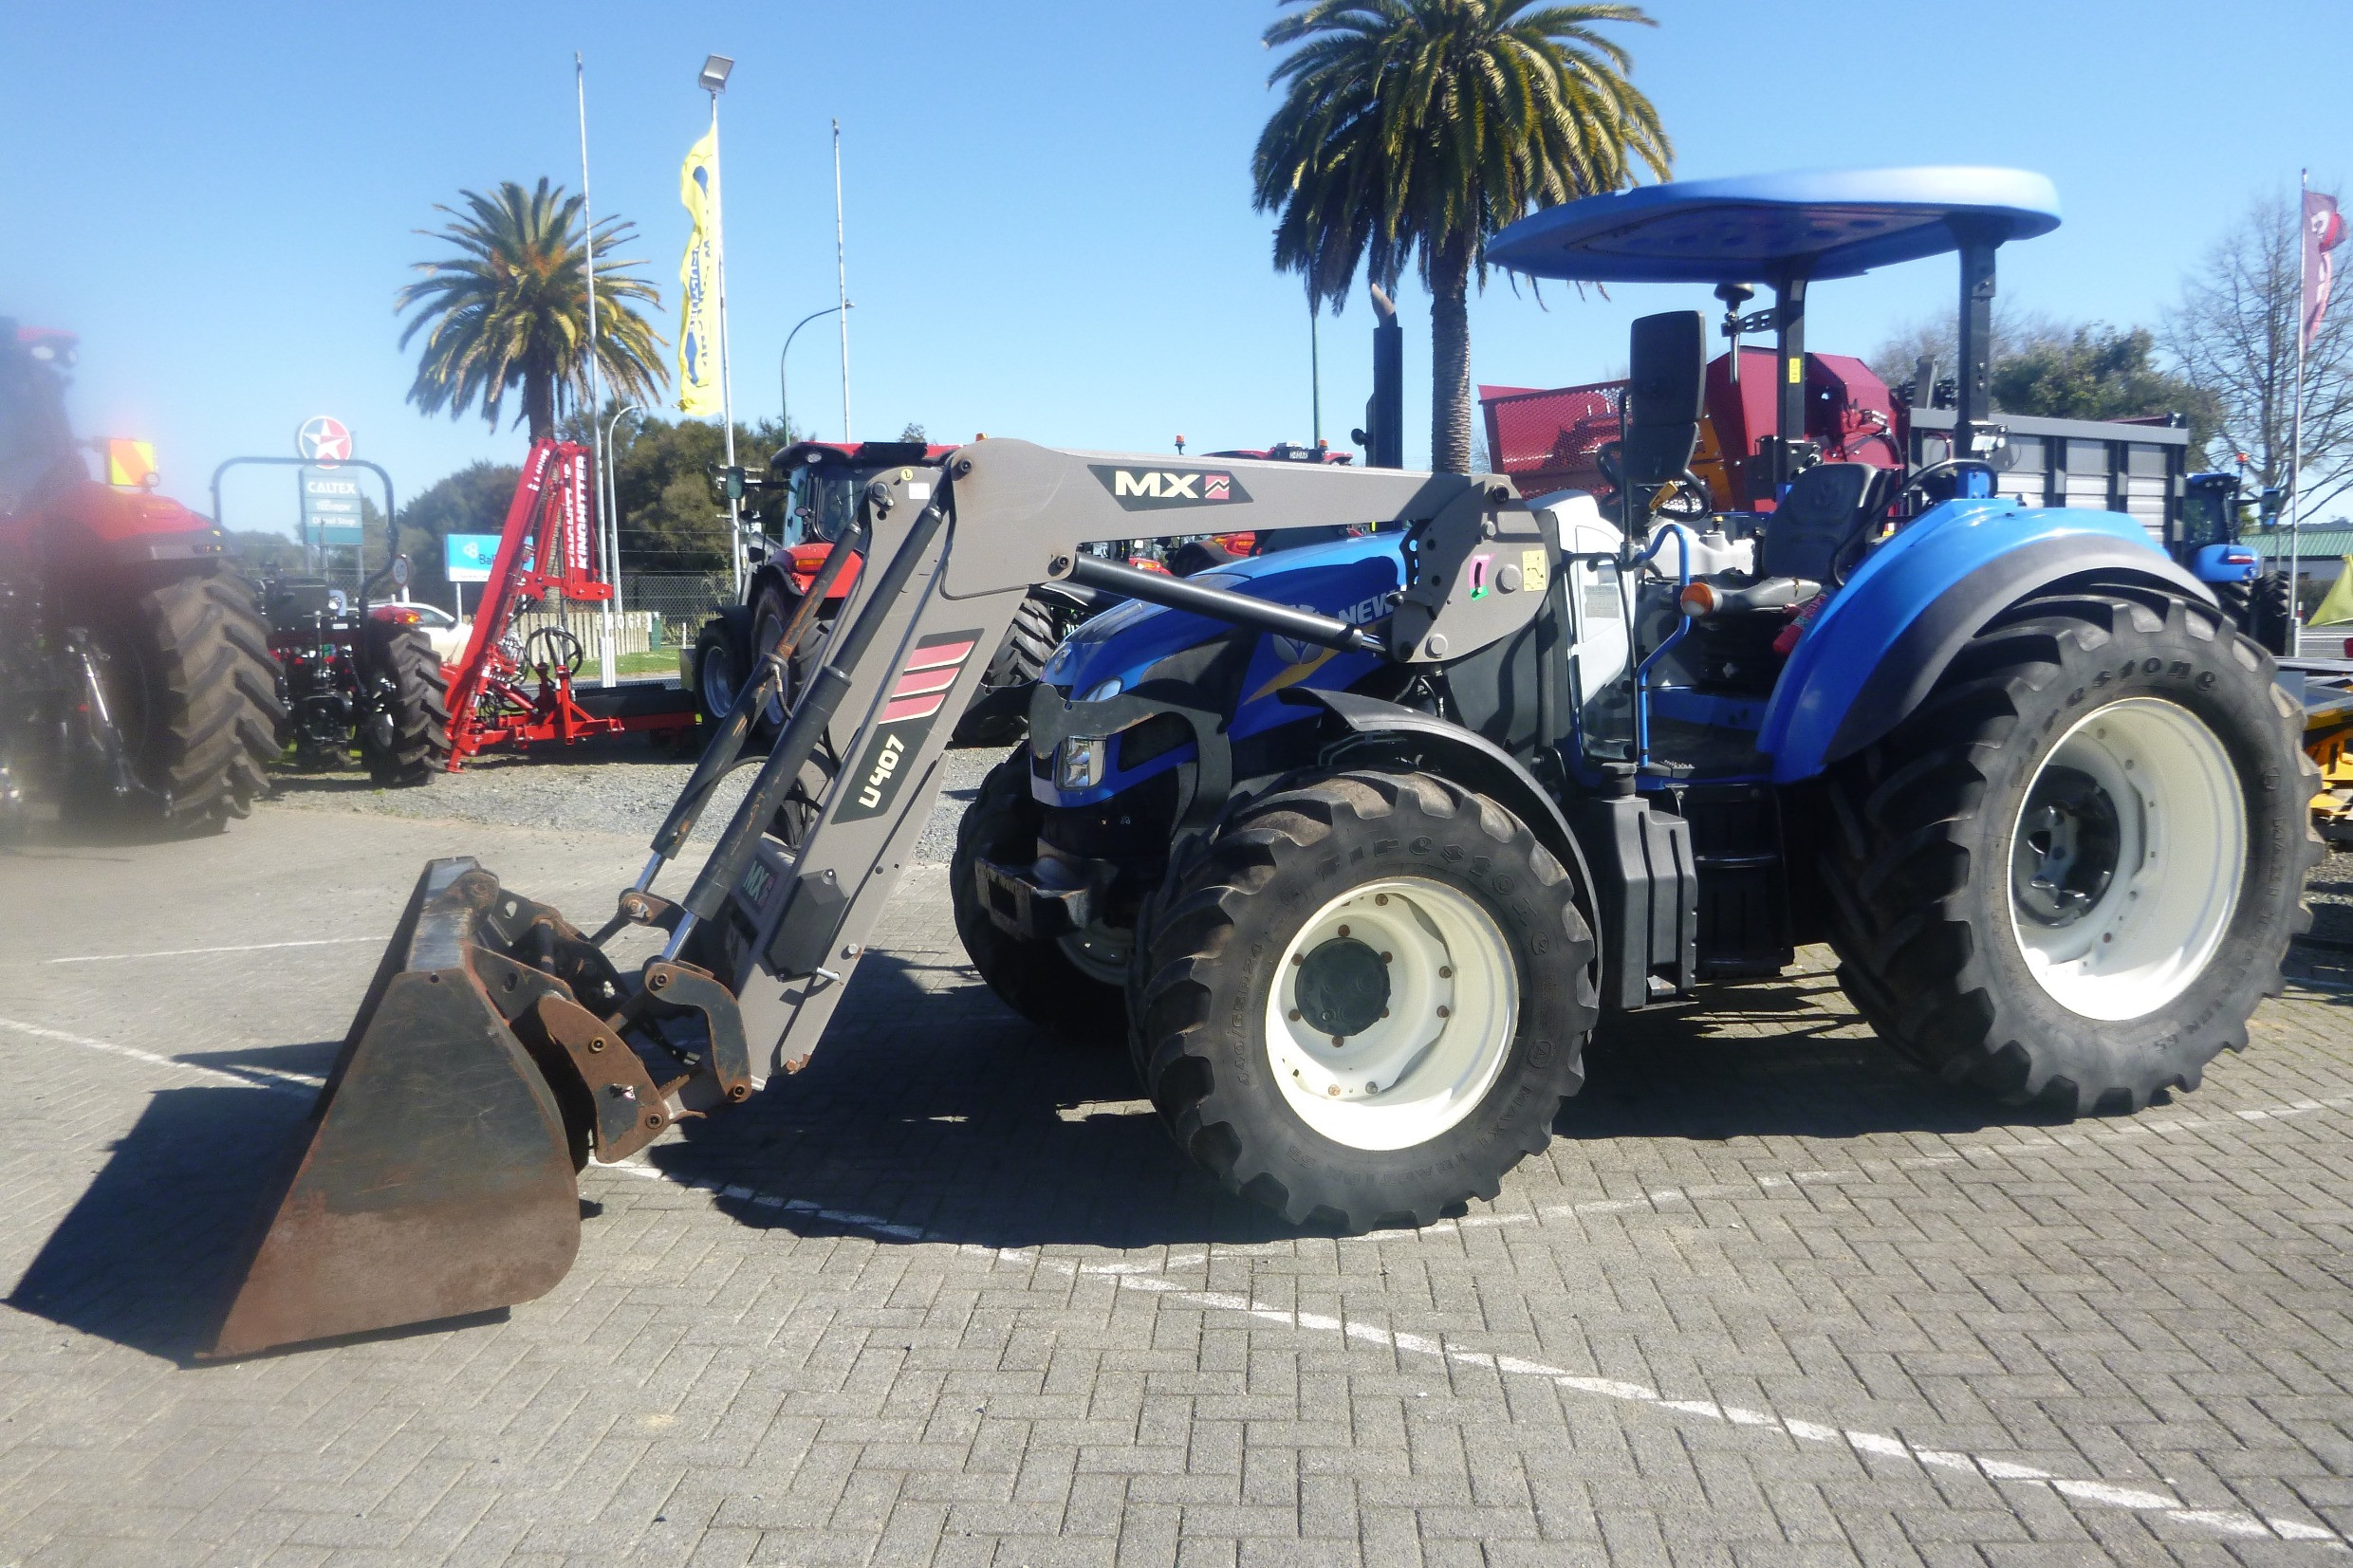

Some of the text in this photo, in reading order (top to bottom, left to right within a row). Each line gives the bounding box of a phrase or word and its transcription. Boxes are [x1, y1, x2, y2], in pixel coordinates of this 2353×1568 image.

[307, 481, 357, 494] CALTEX
[575, 454, 588, 569] KINGHITTER
[1115, 470, 1201, 499] MX
[1338, 590, 1395, 624] NEW
[858, 733, 905, 808] U407
[1315, 835, 1550, 956] Firestone
